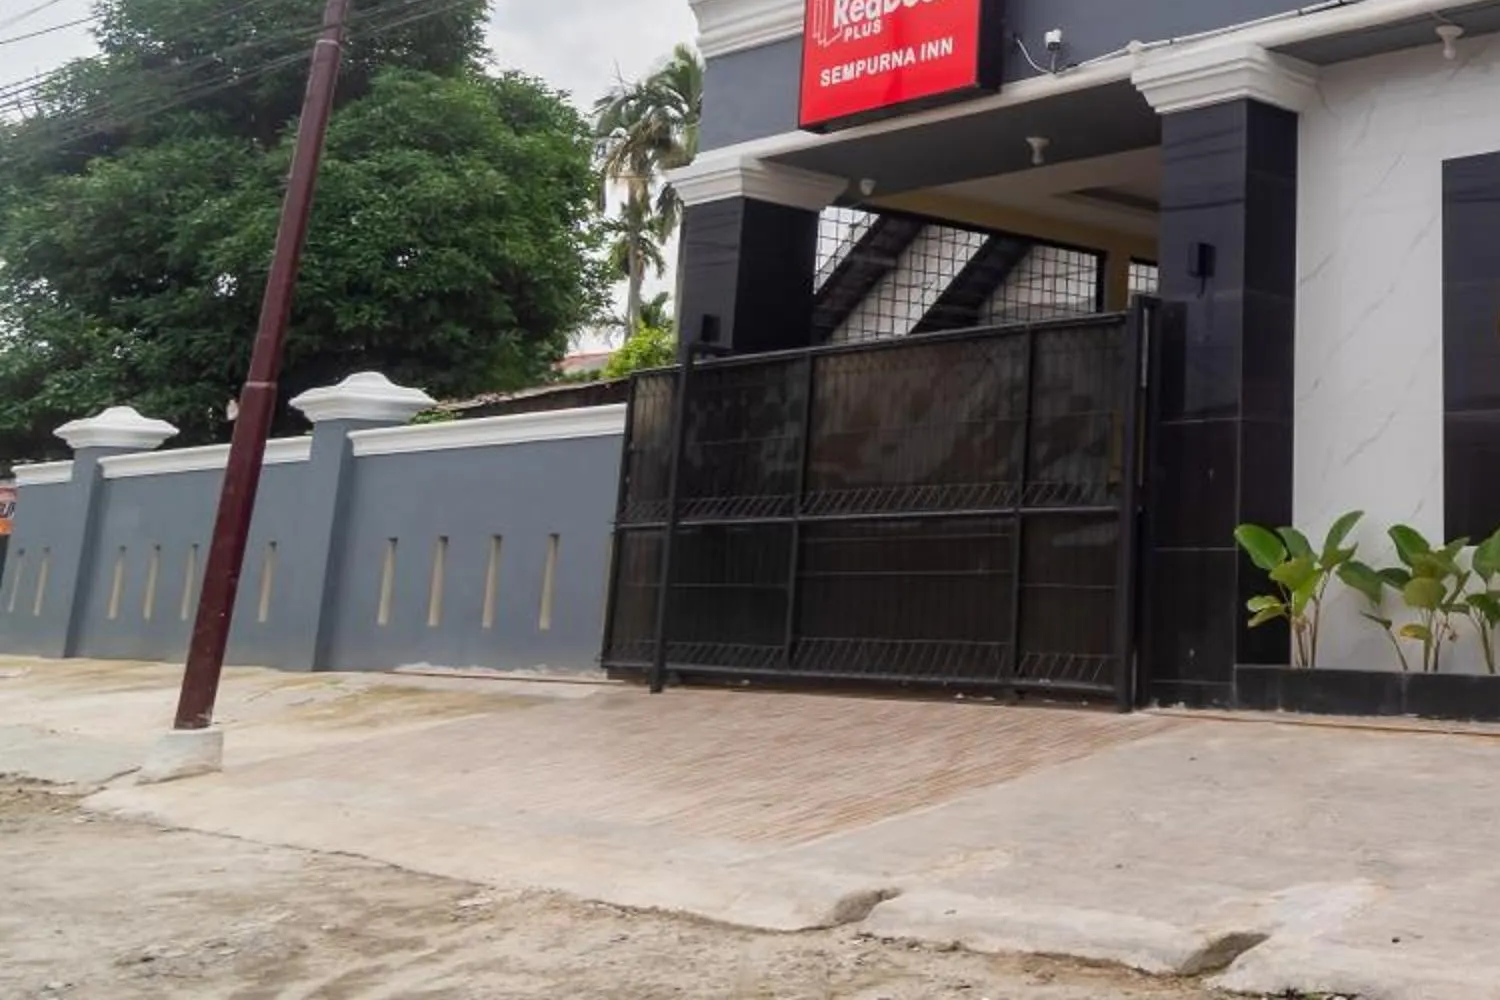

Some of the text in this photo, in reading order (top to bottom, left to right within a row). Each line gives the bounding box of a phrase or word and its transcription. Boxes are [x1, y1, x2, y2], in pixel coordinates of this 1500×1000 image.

[844, 18, 882, 42] PLUS
[820, 37, 954, 87] SEMPURNA INN
